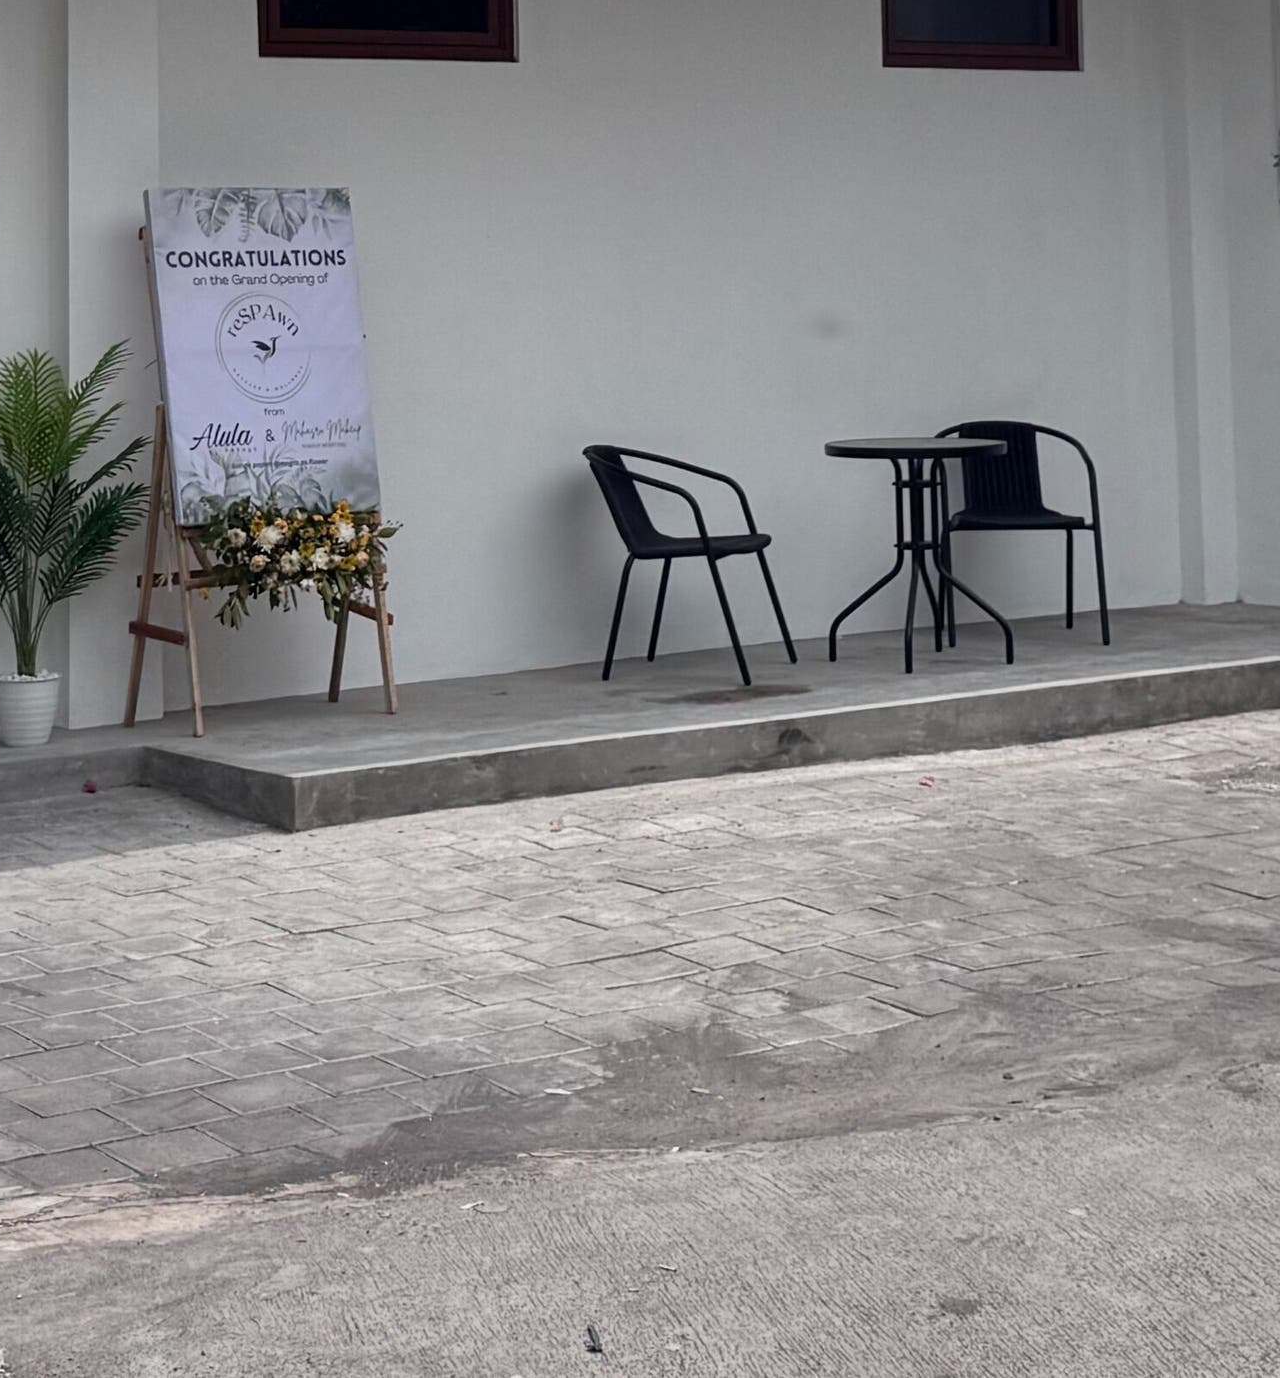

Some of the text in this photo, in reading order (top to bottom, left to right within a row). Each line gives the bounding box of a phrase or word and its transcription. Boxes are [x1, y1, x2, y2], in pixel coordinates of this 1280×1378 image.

[166, 249, 346, 268] CONGRATULATIONS
[193, 272, 328, 286] on the Grand Opening of
[227, 304, 299, 337] reSPAwn
[264, 408, 285, 416] from
[189, 422, 254, 451] Alula
[265, 429, 275, 442] &
